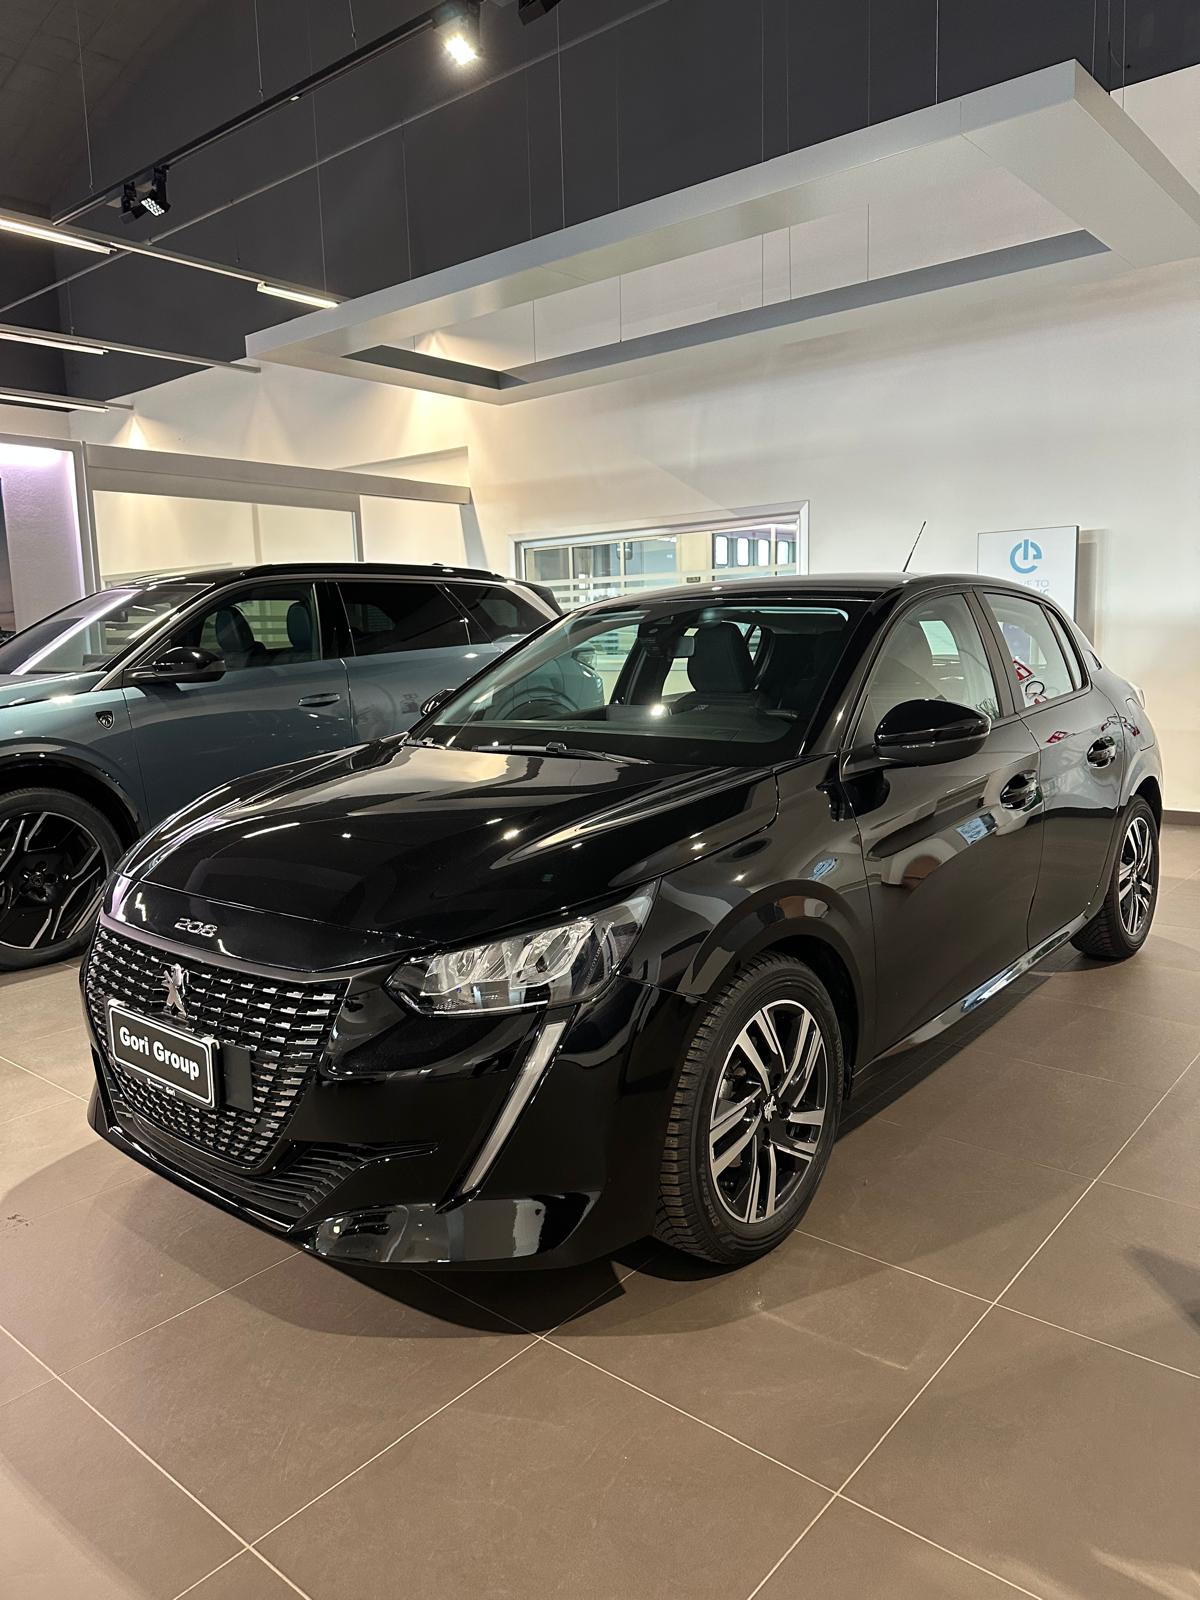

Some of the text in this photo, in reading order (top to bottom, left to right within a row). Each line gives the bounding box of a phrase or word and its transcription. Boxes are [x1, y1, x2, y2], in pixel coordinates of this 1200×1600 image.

[174, 917, 218, 938] 208
[119, 1026, 200, 1081] Gori Group
